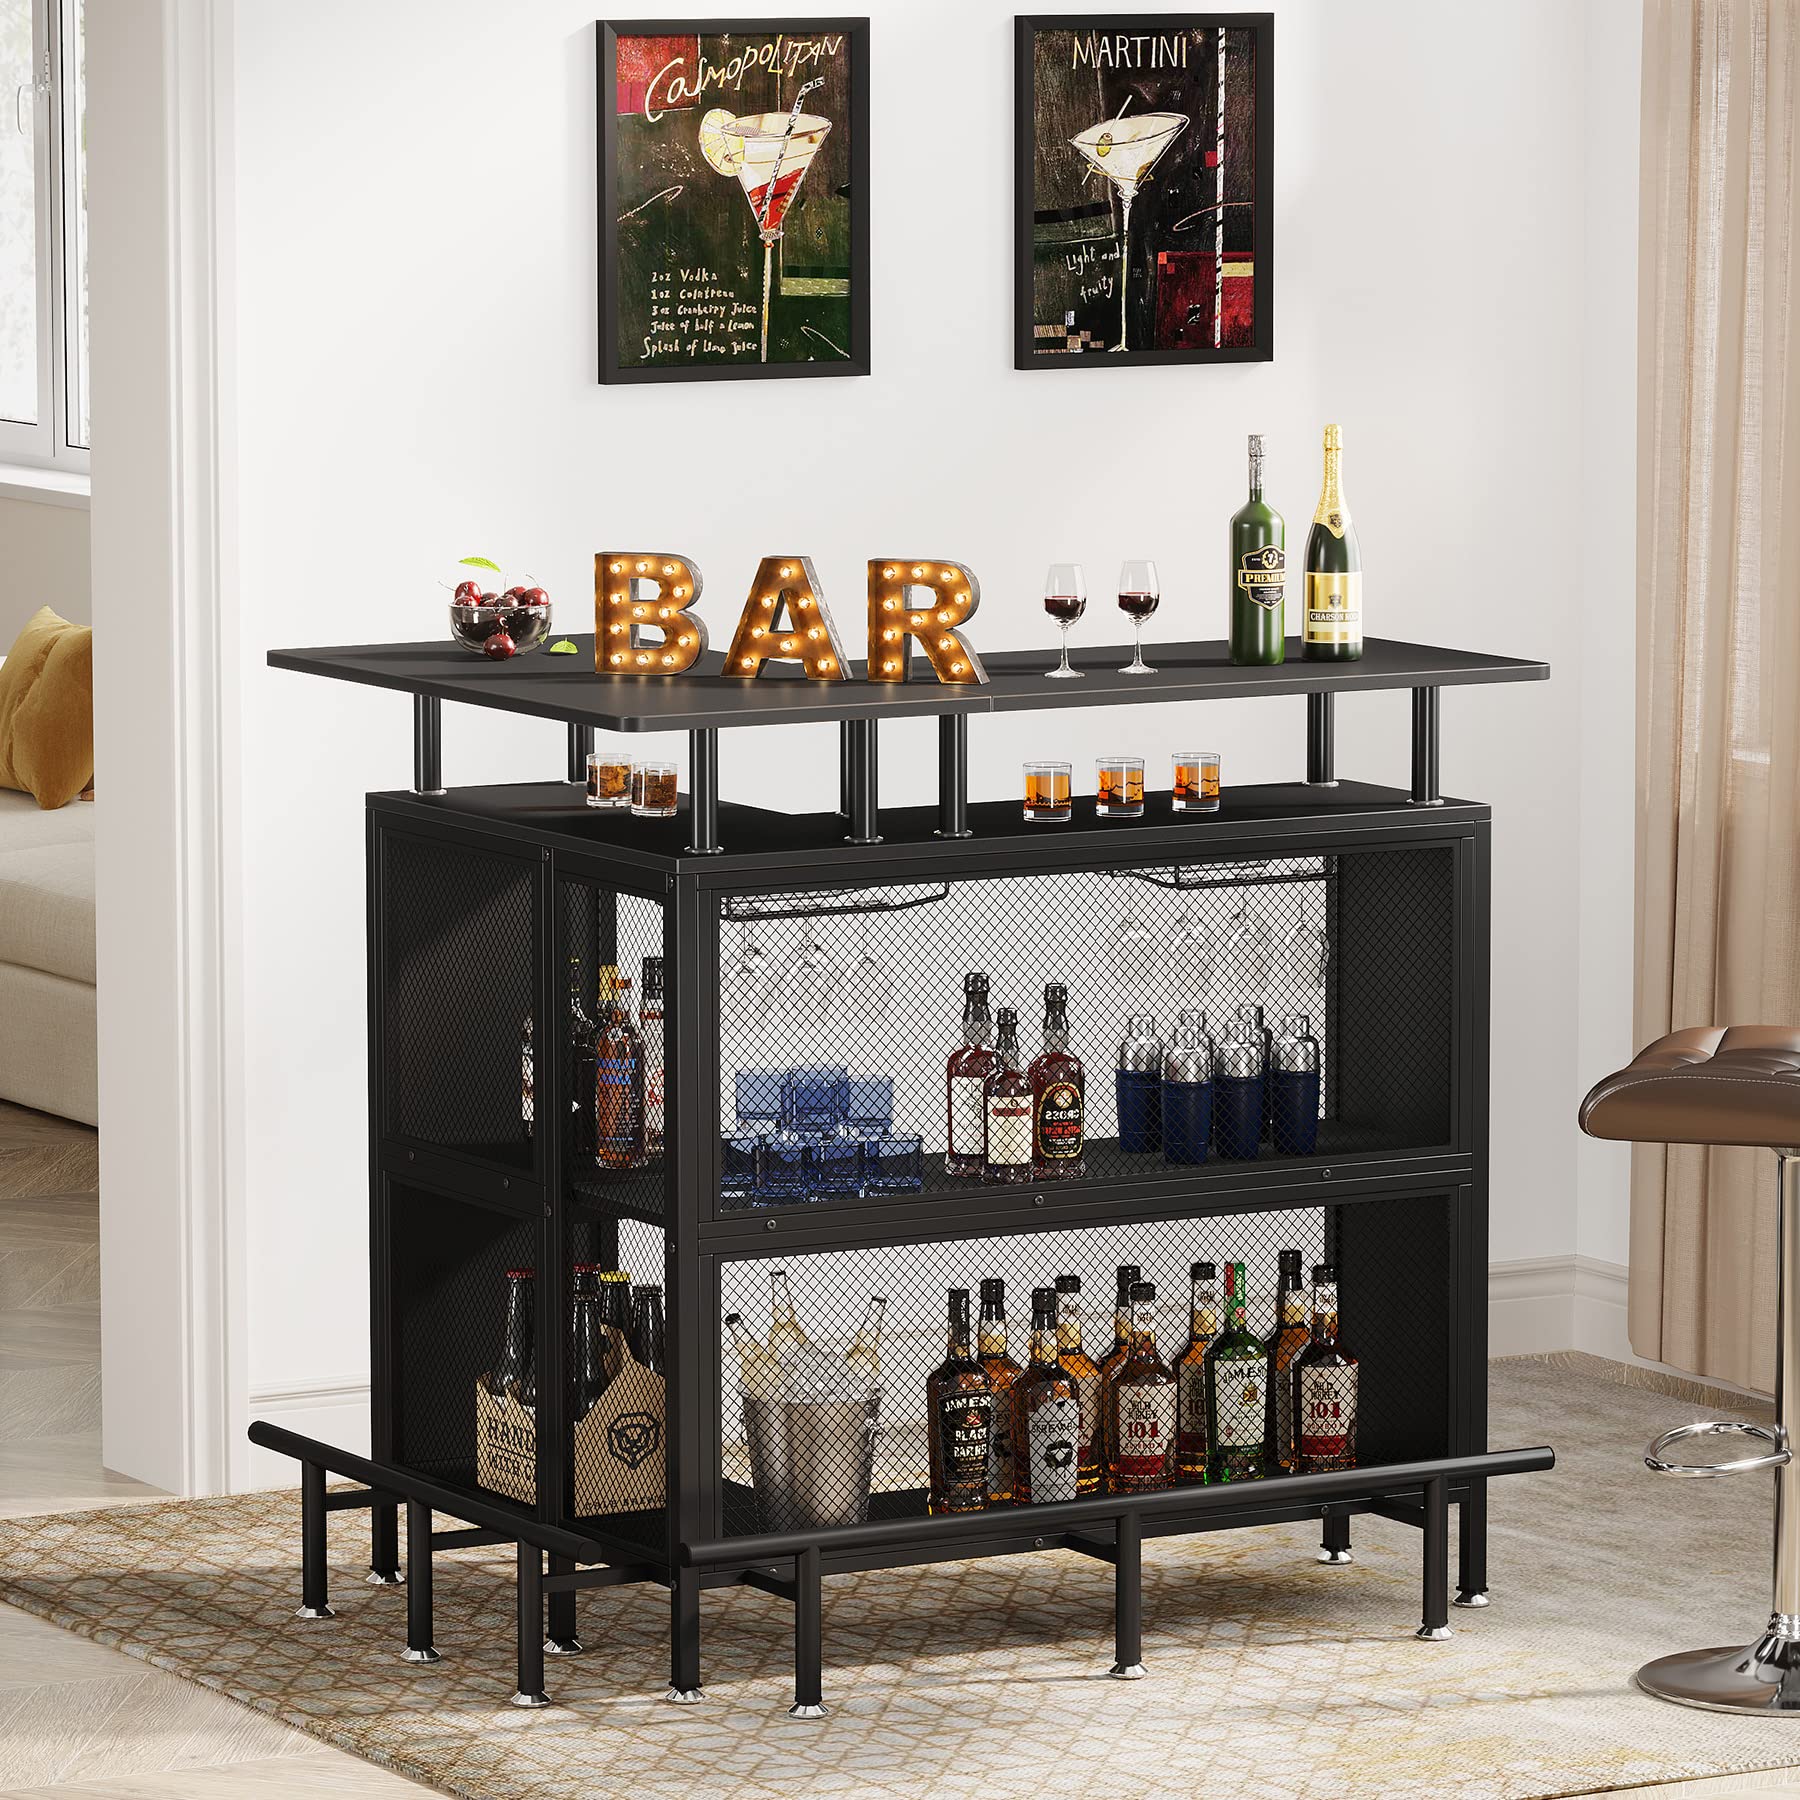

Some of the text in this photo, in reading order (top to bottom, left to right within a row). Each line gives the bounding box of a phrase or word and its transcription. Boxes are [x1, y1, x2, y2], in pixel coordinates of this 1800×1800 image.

[1072, 34, 1188, 70] MARTINI
[1065, 242, 1121, 276] Light and
[679, 267, 718, 282] Vodka
[1080, 275, 1114, 303] fruity
[730, 302, 758, 316] Juice
[640, 336, 680, 359] Splash
[685, 339, 699, 357] of
[594, 551, 991, 686] BAR
[1309, 1401, 1342, 1419] 101
[1126, 1420, 1160, 1438] 101
